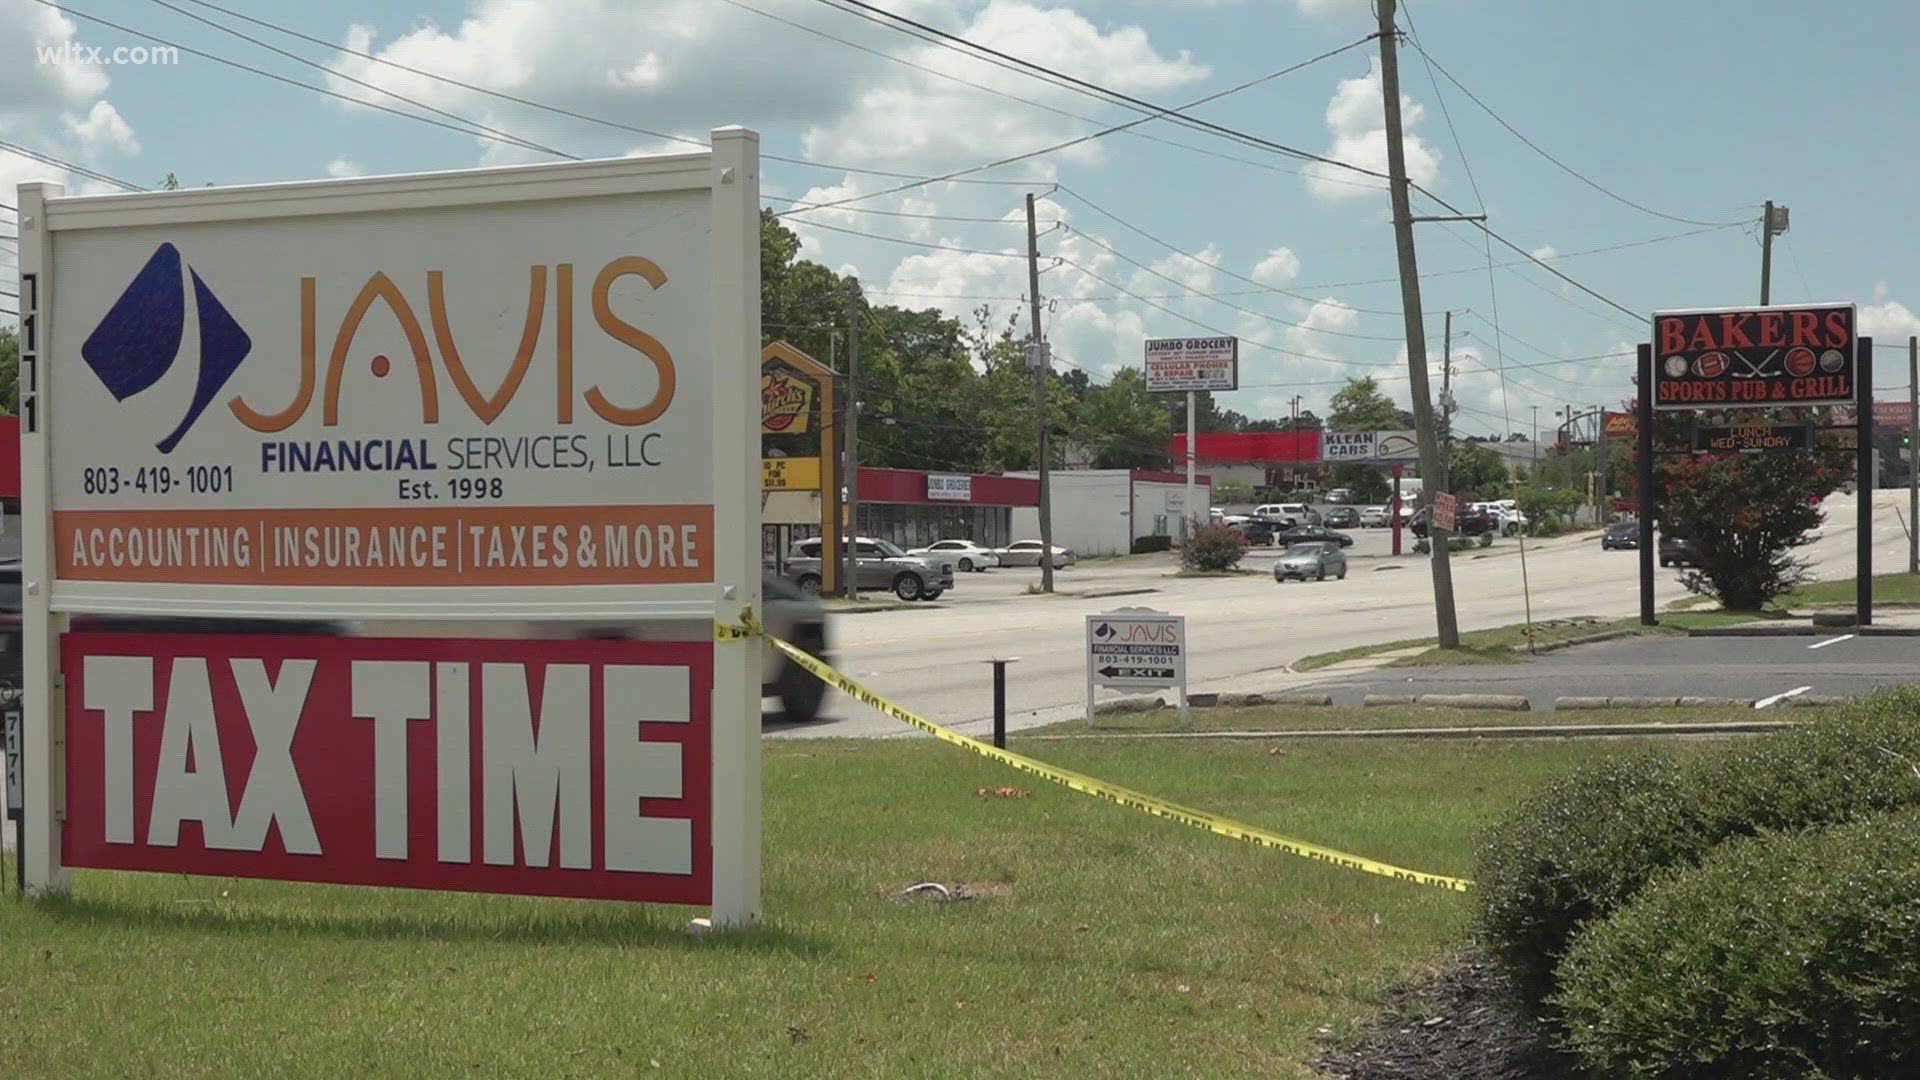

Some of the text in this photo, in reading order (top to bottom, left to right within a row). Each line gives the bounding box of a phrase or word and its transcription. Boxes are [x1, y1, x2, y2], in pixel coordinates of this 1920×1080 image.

[1660, 311, 1848, 355] BAKERS
[228, 256, 676, 432] JAVIS
[1148, 340, 1232, 351] JUMBO GROCERY
[1193, 361, 1229, 369] PHONES
[1659, 375, 1849, 400] SPORTS PUB & GRILL
[1325, 433, 1373, 446] KLEAN
[1730, 425, 1771, 438] LUNCH
[1328, 444, 1368, 456] CARS
[1710, 437, 1791, 448] WED-SUNDAY
[262, 433, 661, 473] FINANCIAL SERVICES, LLC
[83, 466, 233, 494] 803-419-1001
[398, 478, 503, 500] Est. 1998
[73, 527, 251, 567] ACCOUNTING
[274, 525, 448, 567] INSURANCE
[1121, 624, 1176, 643] JAVIS
[1094, 645, 1178, 655] FINANCIAL SERVICES LLC
[1098, 656, 1173, 664] 803-419-1001
[1118, 669, 1167, 677] EXIT
[7, 716, 18, 786] 7171
[83, 656, 693, 876] TAX TIME
